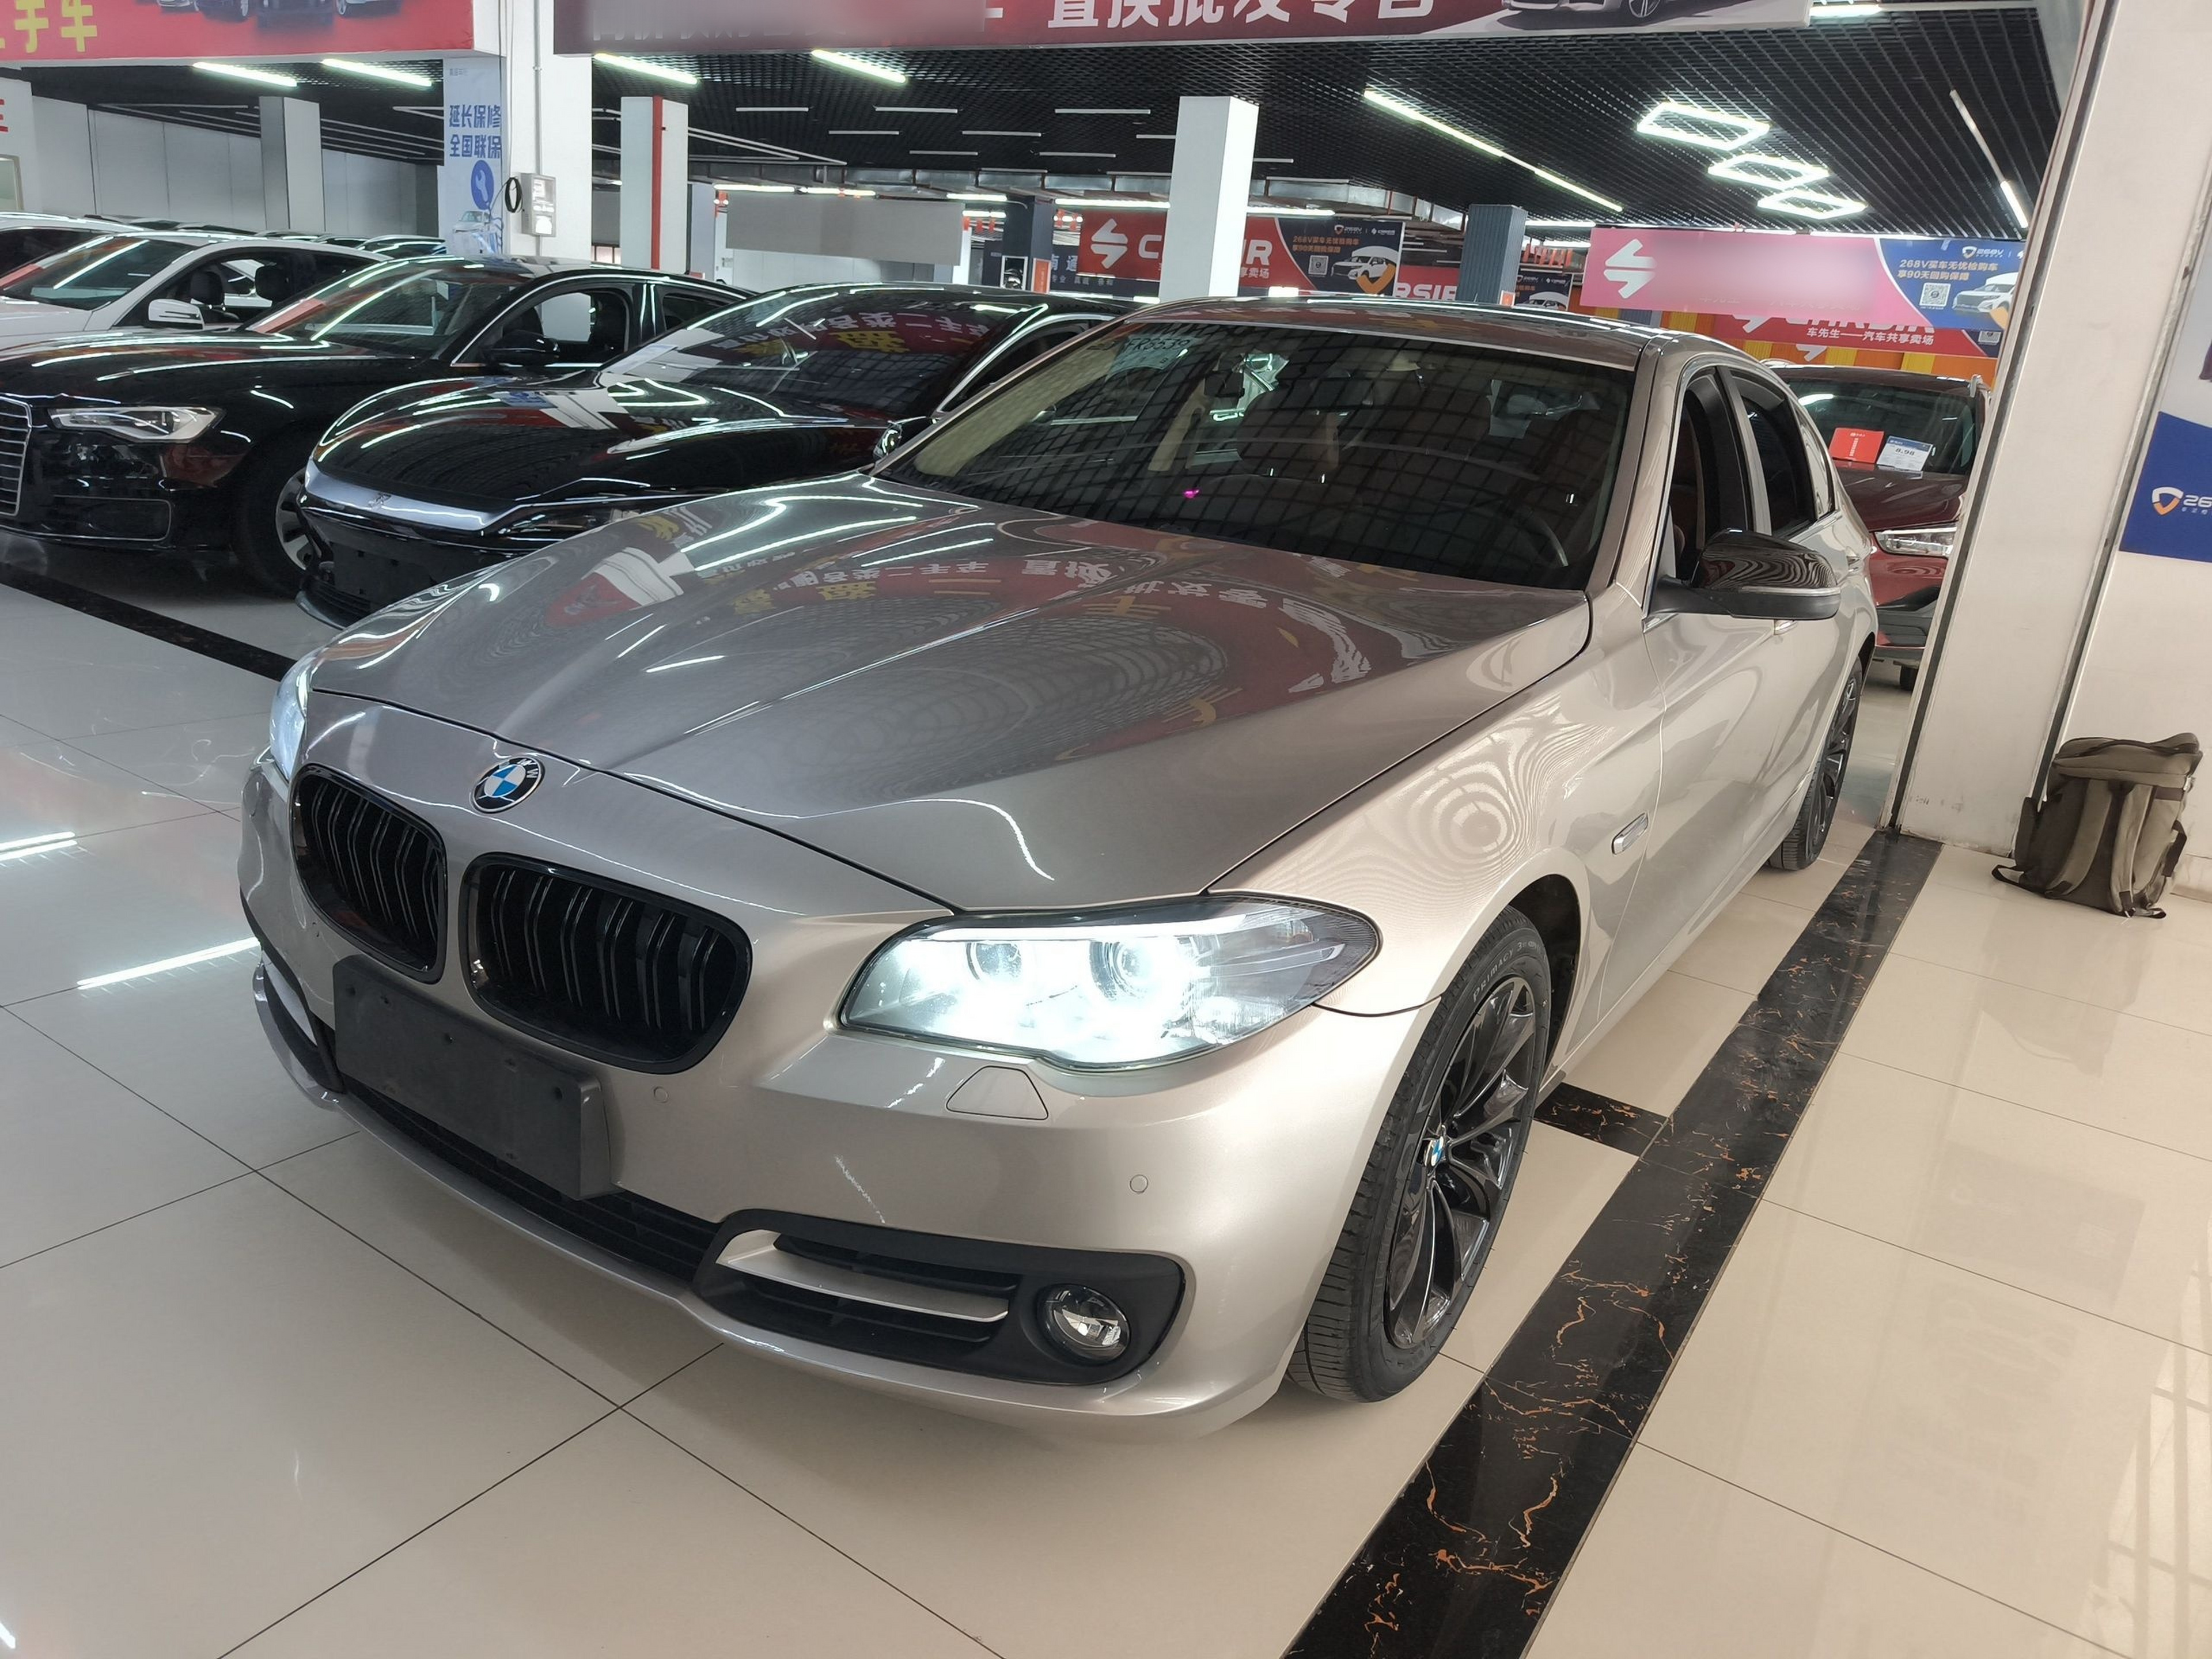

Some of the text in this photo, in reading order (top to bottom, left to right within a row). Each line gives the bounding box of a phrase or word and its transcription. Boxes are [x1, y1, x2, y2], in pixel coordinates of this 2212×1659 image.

[0, 0, 98, 53] 手车
[449, 104, 501, 128] 延长保修
[449, 134, 501, 158] 全国联保
